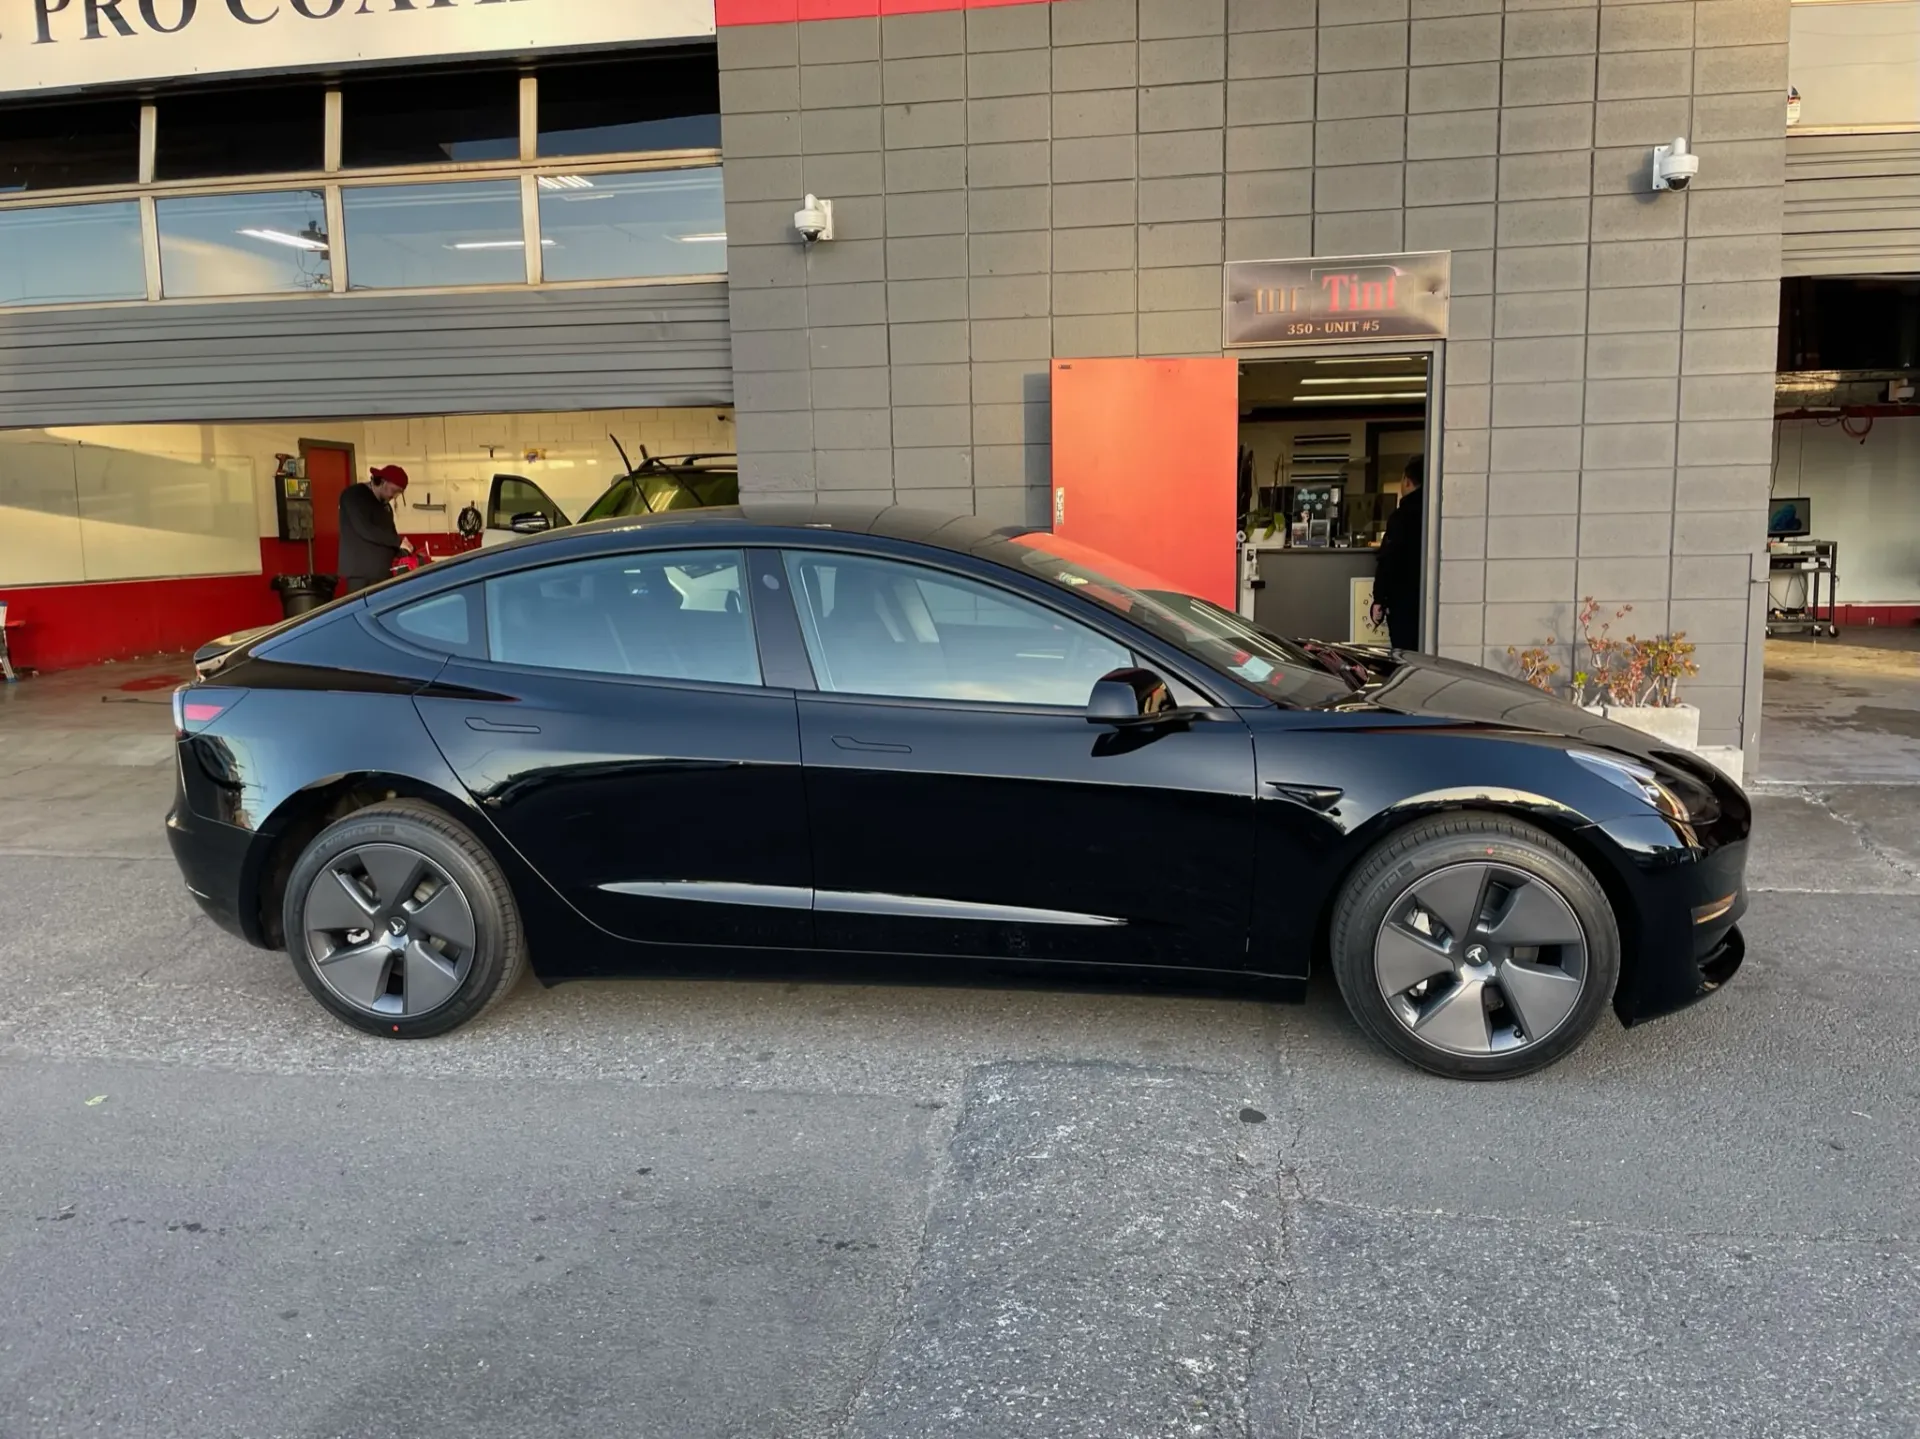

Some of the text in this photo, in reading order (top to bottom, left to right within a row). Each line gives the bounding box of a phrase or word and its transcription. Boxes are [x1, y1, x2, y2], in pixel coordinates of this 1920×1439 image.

[1287, 323, 1313, 335] 350
[1325, 321, 1359, 333] UNIT
[1362, 320, 1380, 332] #5
